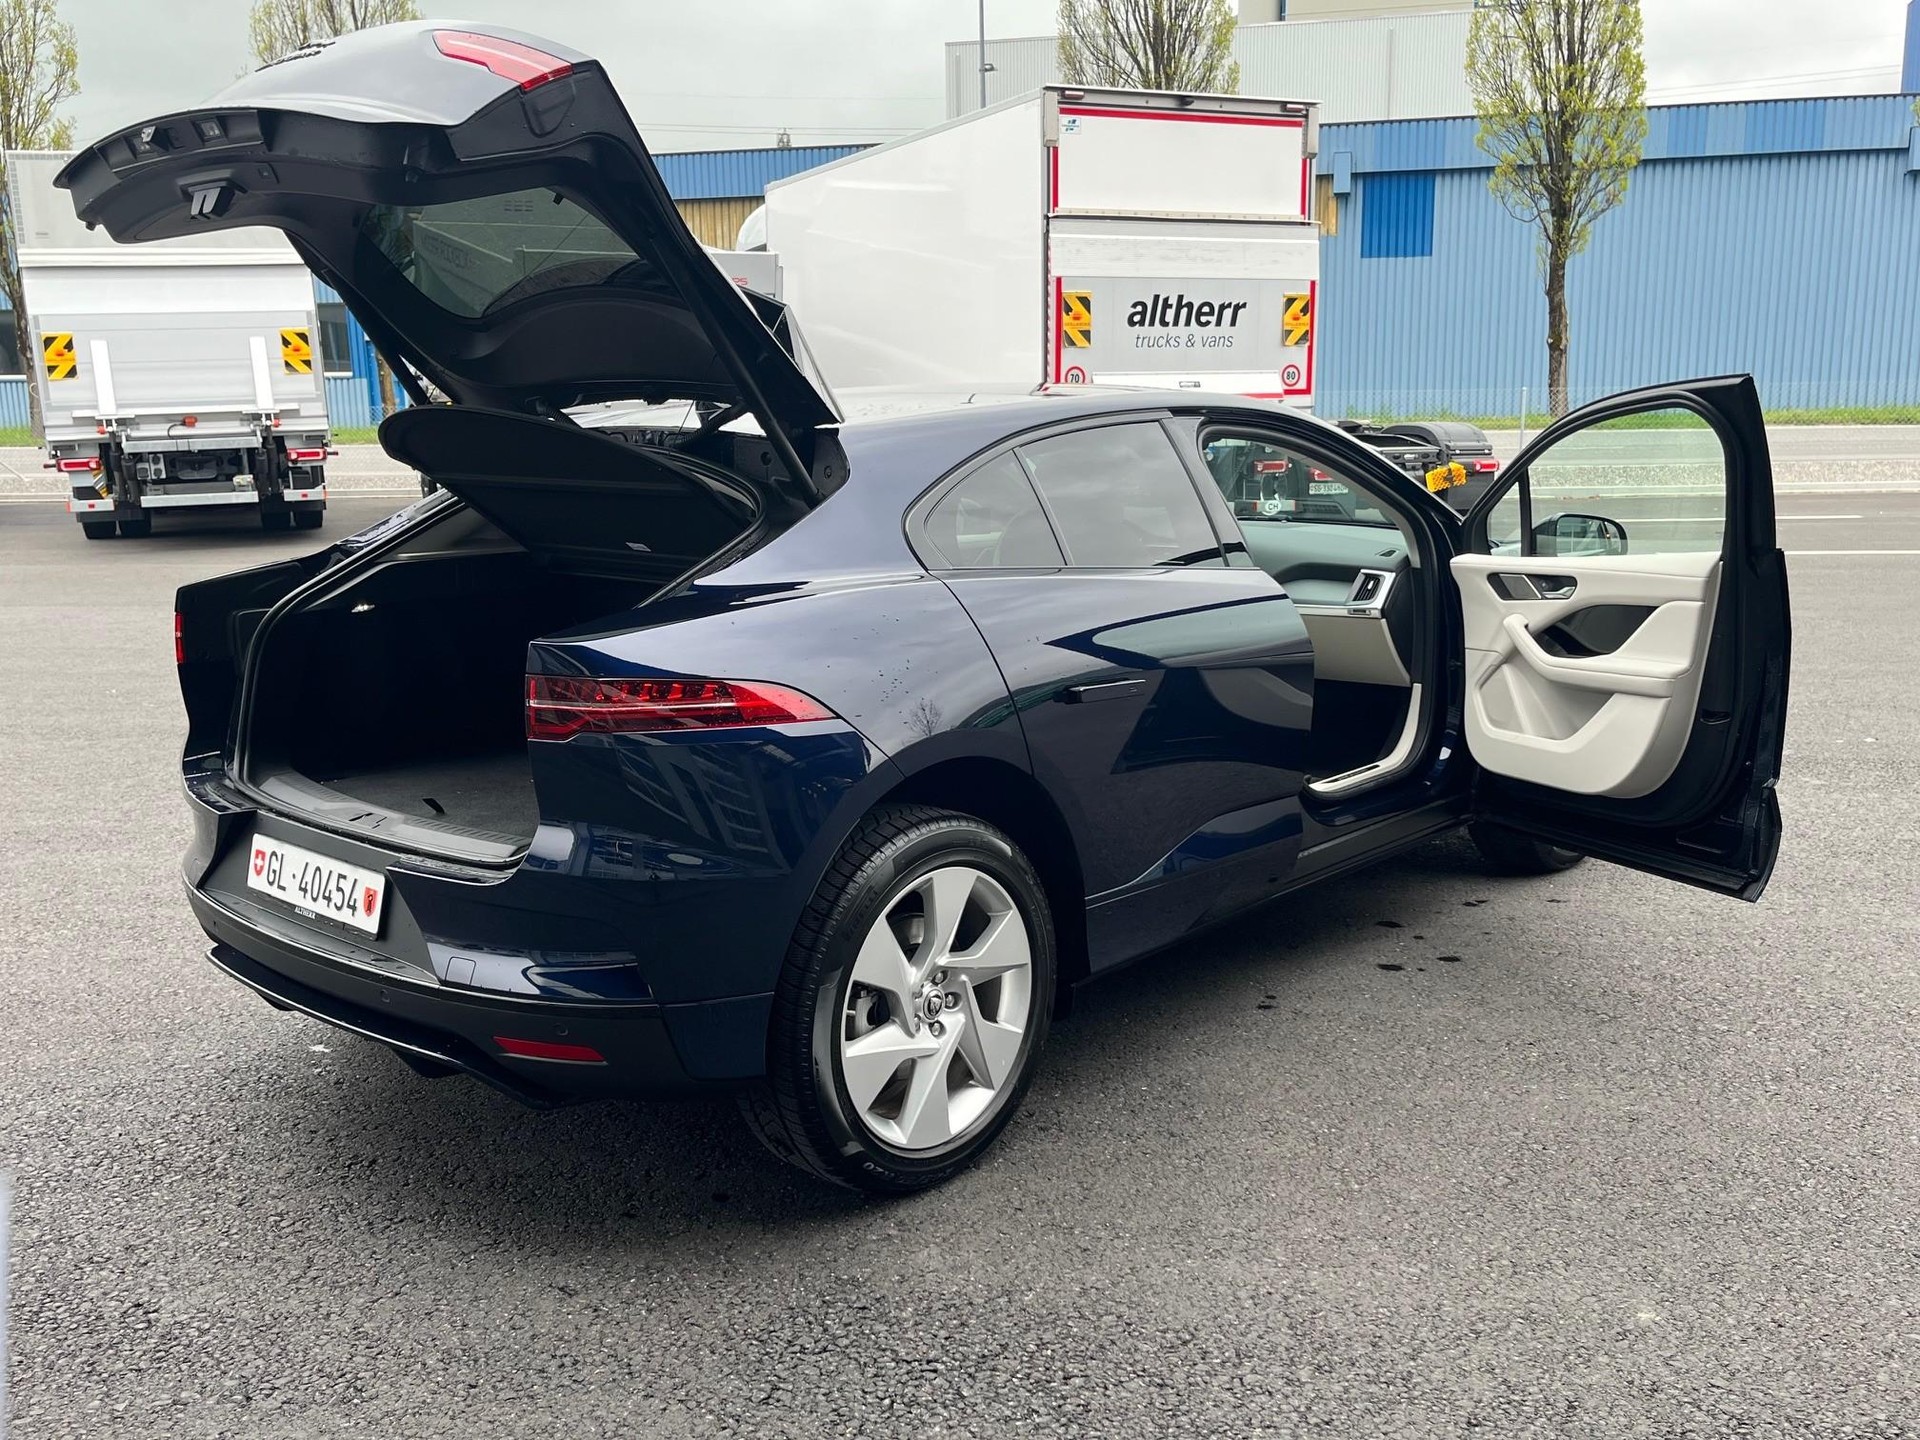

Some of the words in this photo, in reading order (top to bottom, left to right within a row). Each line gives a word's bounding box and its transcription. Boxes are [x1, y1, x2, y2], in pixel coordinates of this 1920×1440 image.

[1127, 294, 1247, 327] altherr
[1135, 333, 1181, 348] trucks
[1185, 333, 1196, 348] &
[1201, 334, 1234, 348] vans
[1070, 373, 1080, 384] 70
[1286, 371, 1296, 380] 80
